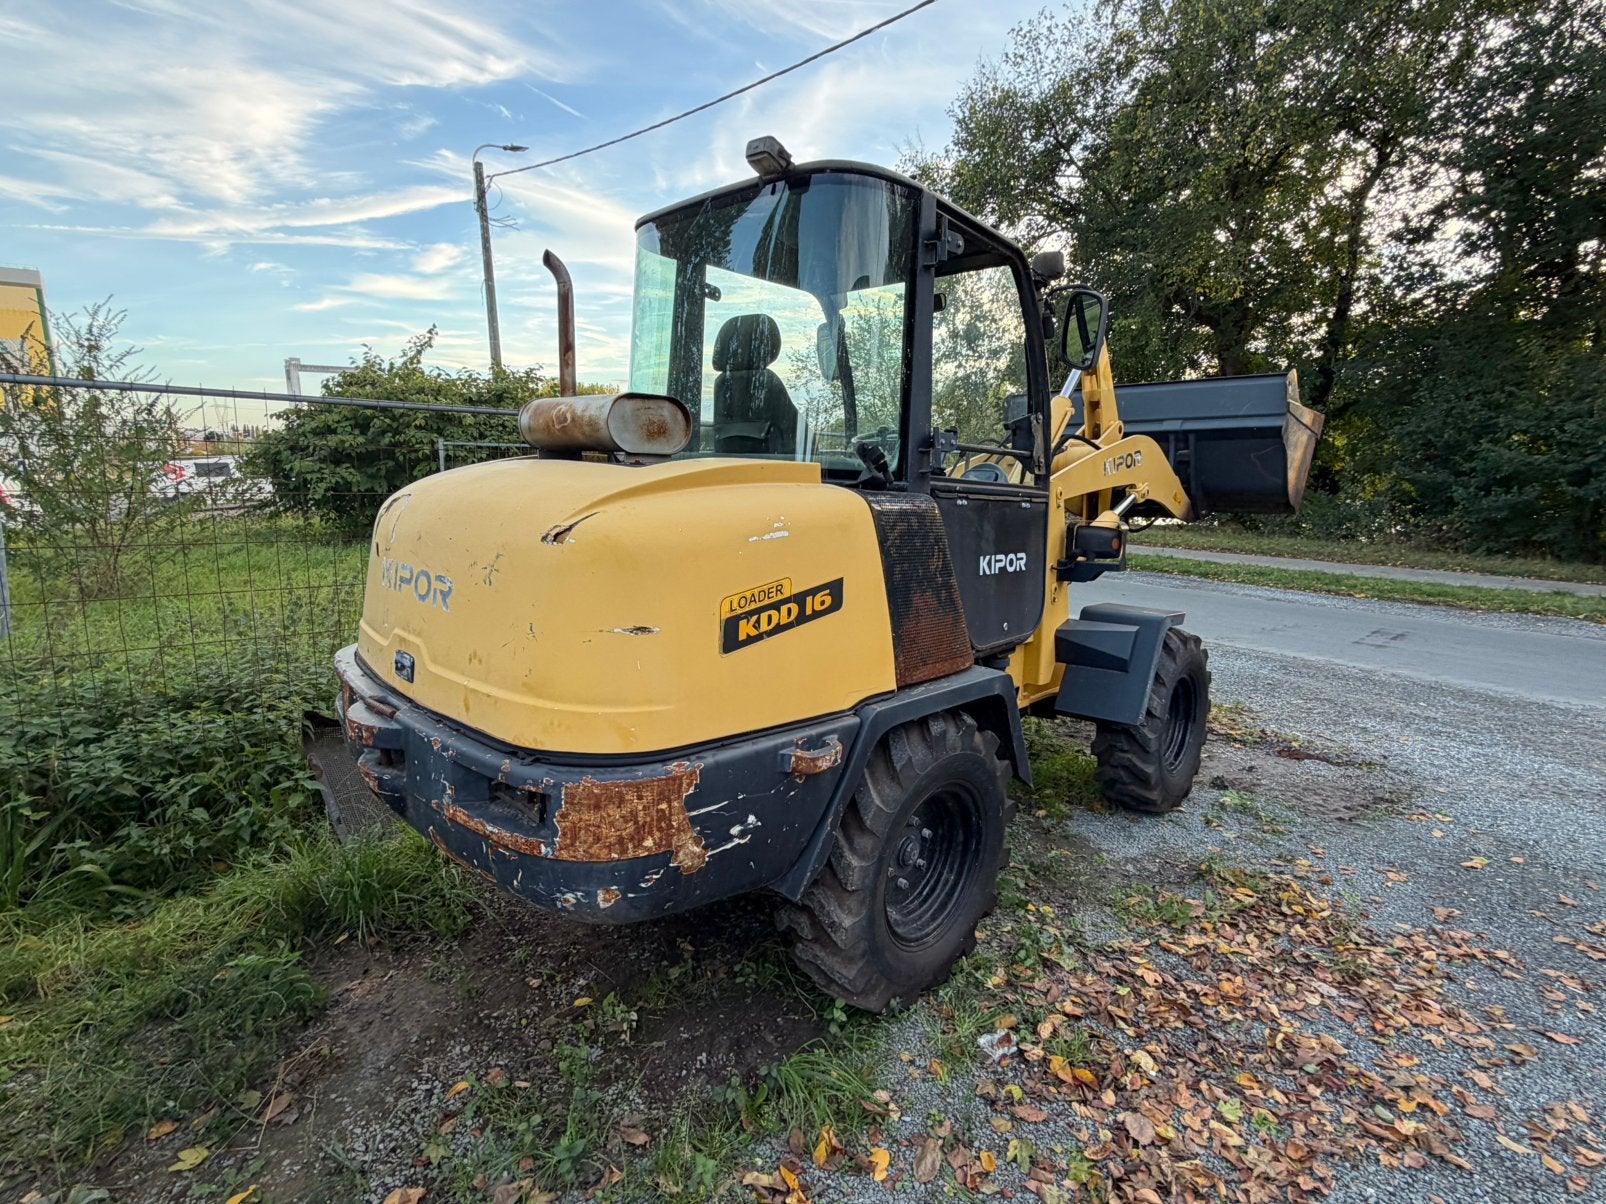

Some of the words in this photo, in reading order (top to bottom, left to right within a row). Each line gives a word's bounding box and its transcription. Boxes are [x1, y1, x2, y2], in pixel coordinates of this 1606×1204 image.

[1103, 449, 1142, 476] KIPOR
[979, 552, 1027, 576] KIPOR
[382, 556, 453, 613] KIPOR
[729, 583, 784, 613] LOADER
[738, 602, 799, 641] KDD
[805, 589, 832, 616] 16
